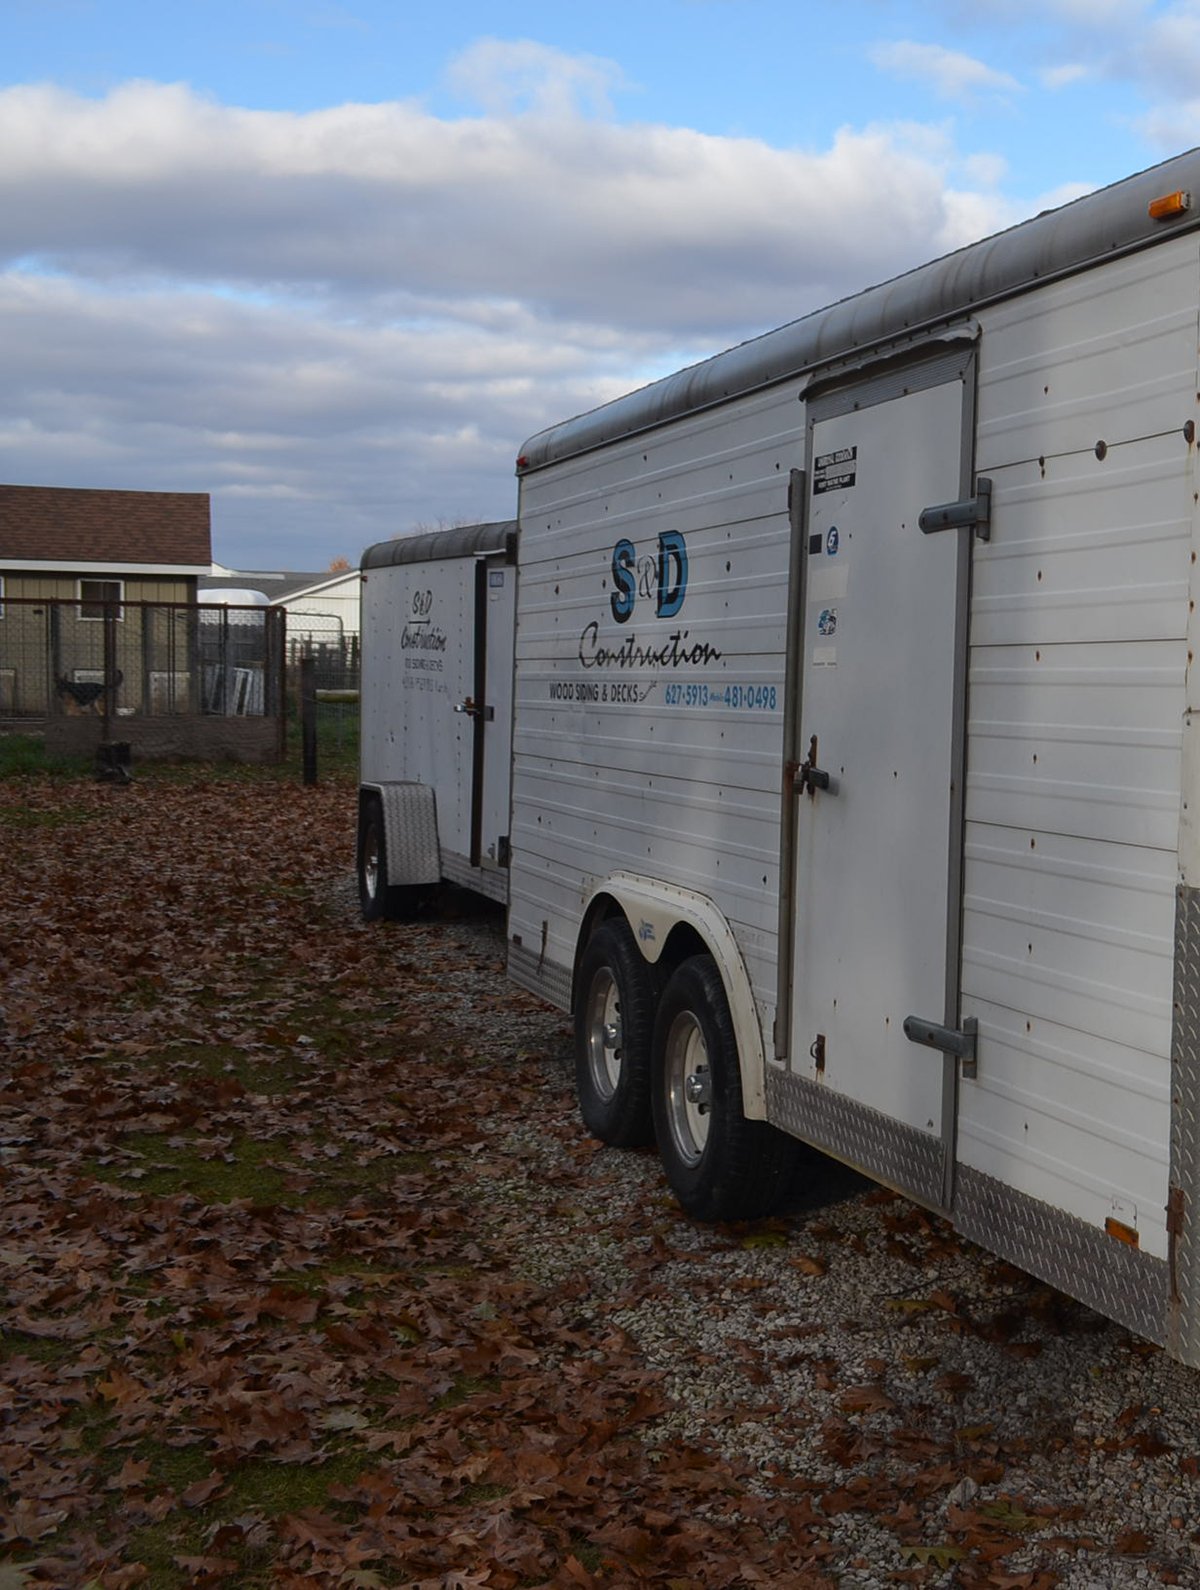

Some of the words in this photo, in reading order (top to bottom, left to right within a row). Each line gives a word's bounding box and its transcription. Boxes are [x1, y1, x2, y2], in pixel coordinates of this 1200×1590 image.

[578, 620, 722, 668] Construction
[549, 682, 574, 700] WOOD
[602, 684, 608, 702] &
[611, 684, 638, 703] DECKS
